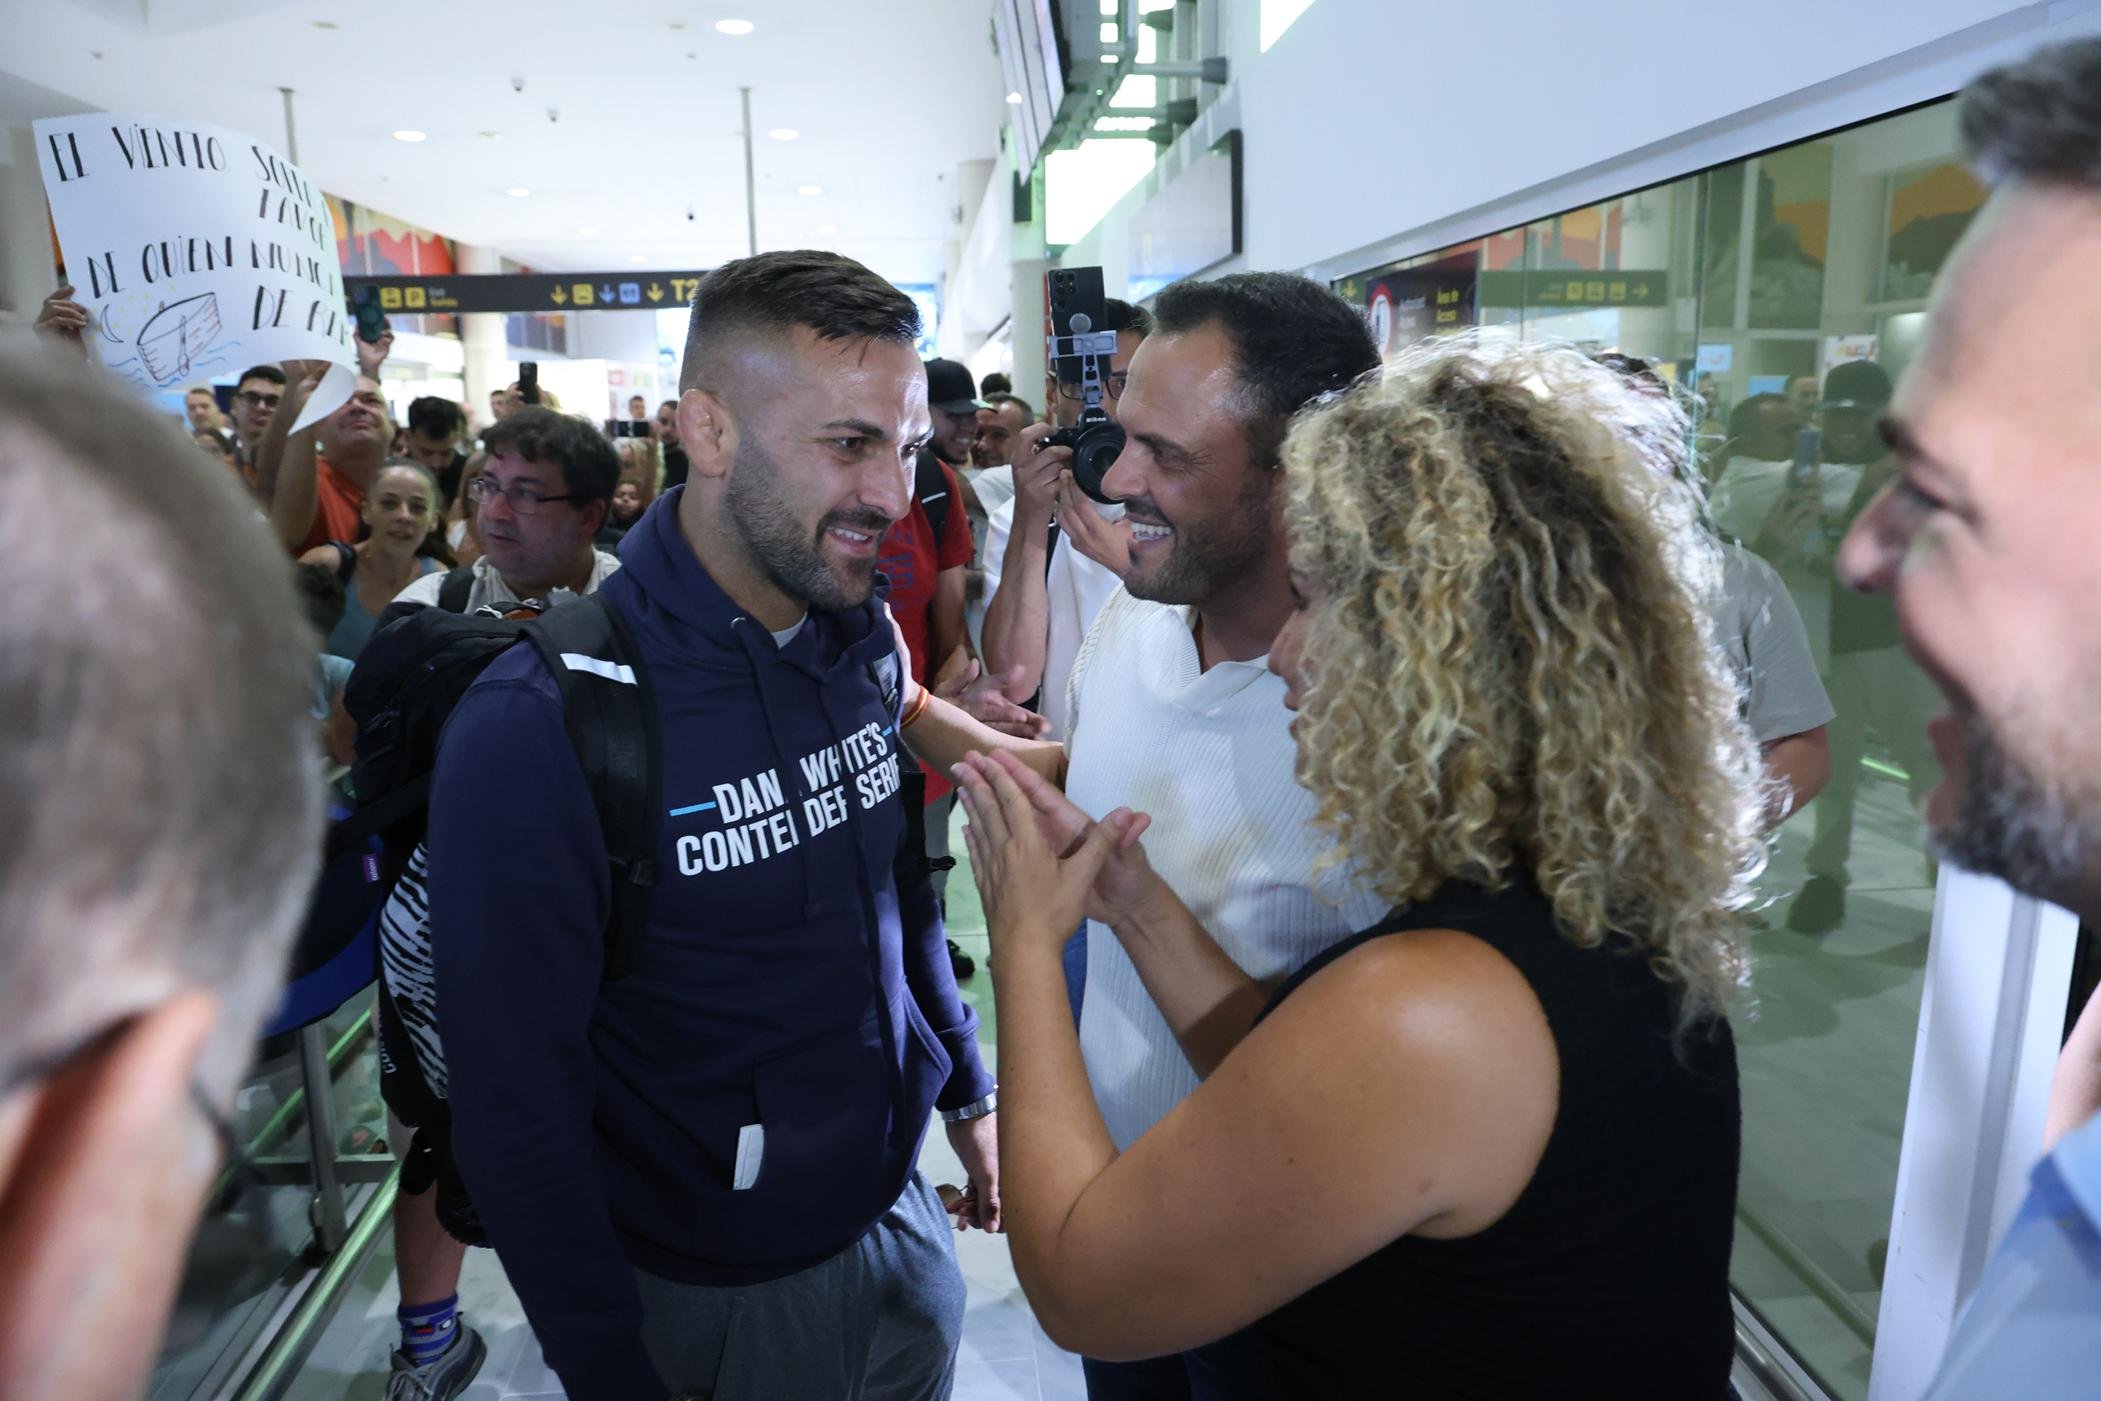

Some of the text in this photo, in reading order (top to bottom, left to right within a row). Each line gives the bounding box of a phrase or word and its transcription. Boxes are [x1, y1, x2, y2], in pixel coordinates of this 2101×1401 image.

[48, 132, 90, 182] EL
[87, 251, 126, 299] DE
[253, 285, 295, 331] DE
[712, 721, 888, 824] DAN WHITE'S
